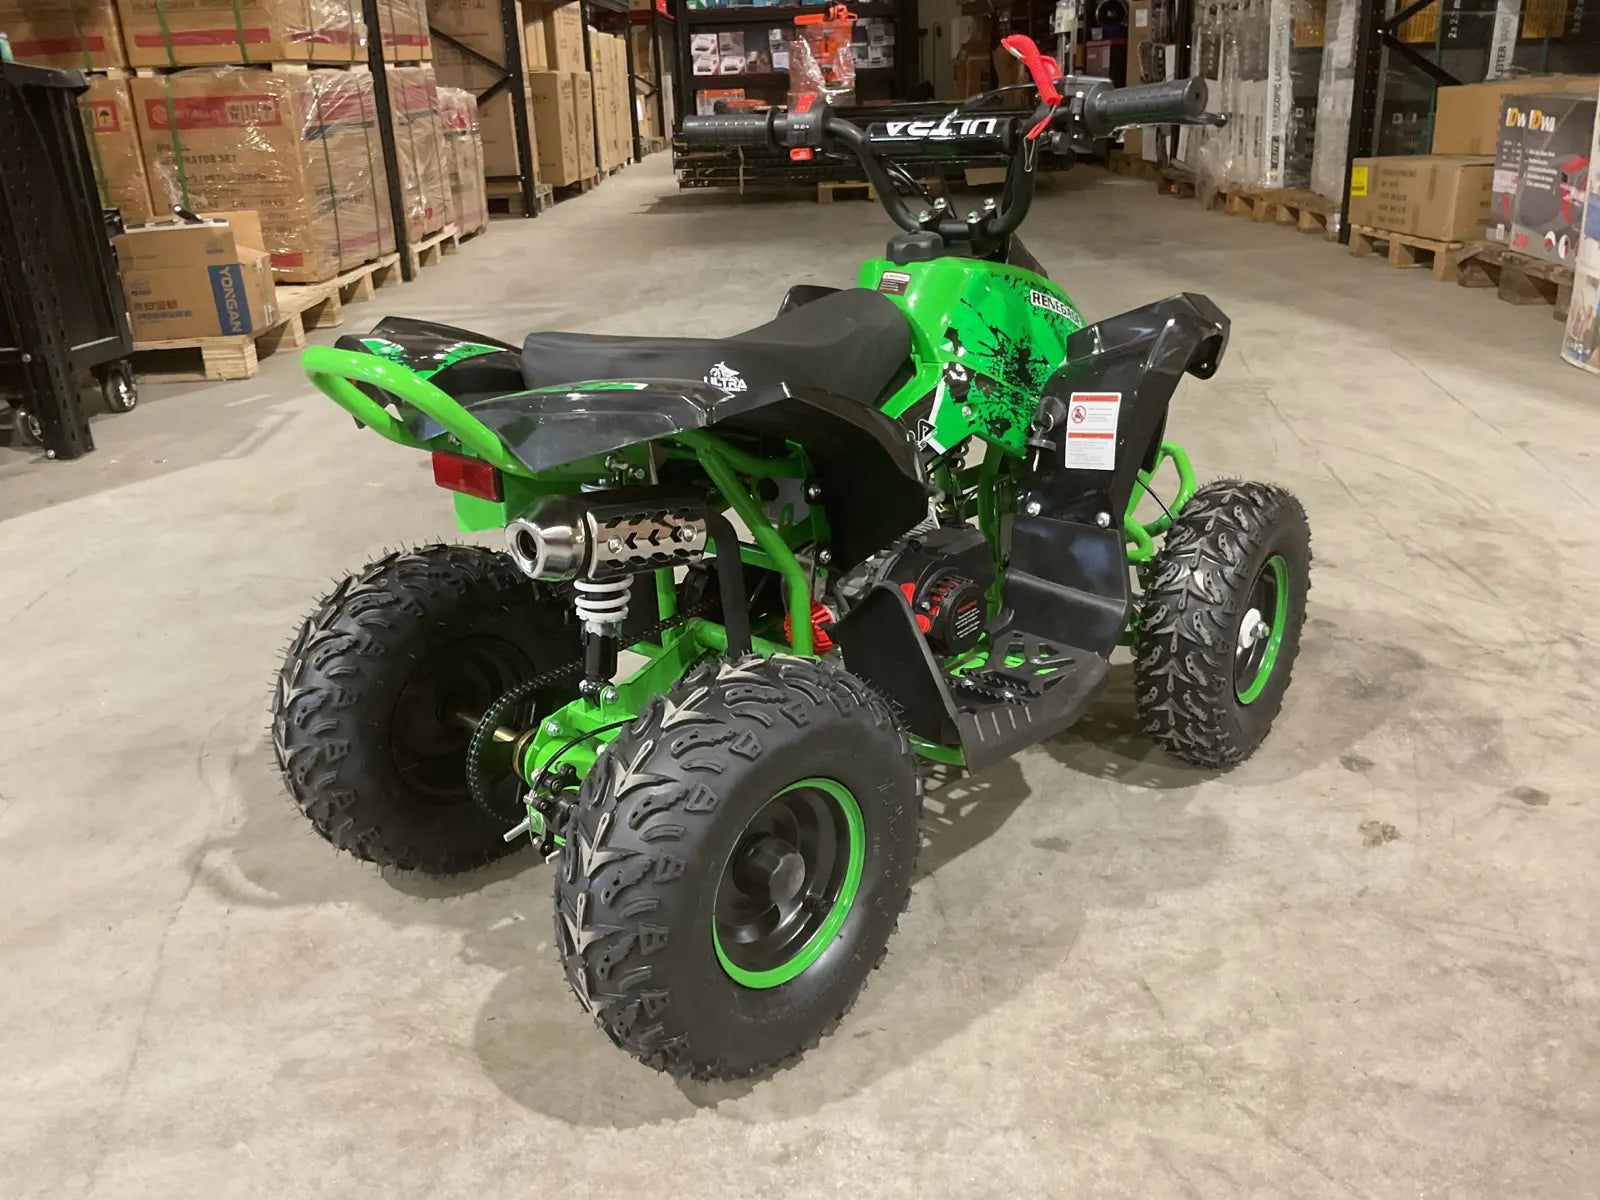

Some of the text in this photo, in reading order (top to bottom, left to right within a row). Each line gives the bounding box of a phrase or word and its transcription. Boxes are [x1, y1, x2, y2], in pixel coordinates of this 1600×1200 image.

[1494, 45, 1507, 79] LEITER
[885, 118, 998, 137] ULTRA
[219, 266, 243, 333] YONGAN
[703, 376, 748, 389] ULTRA
